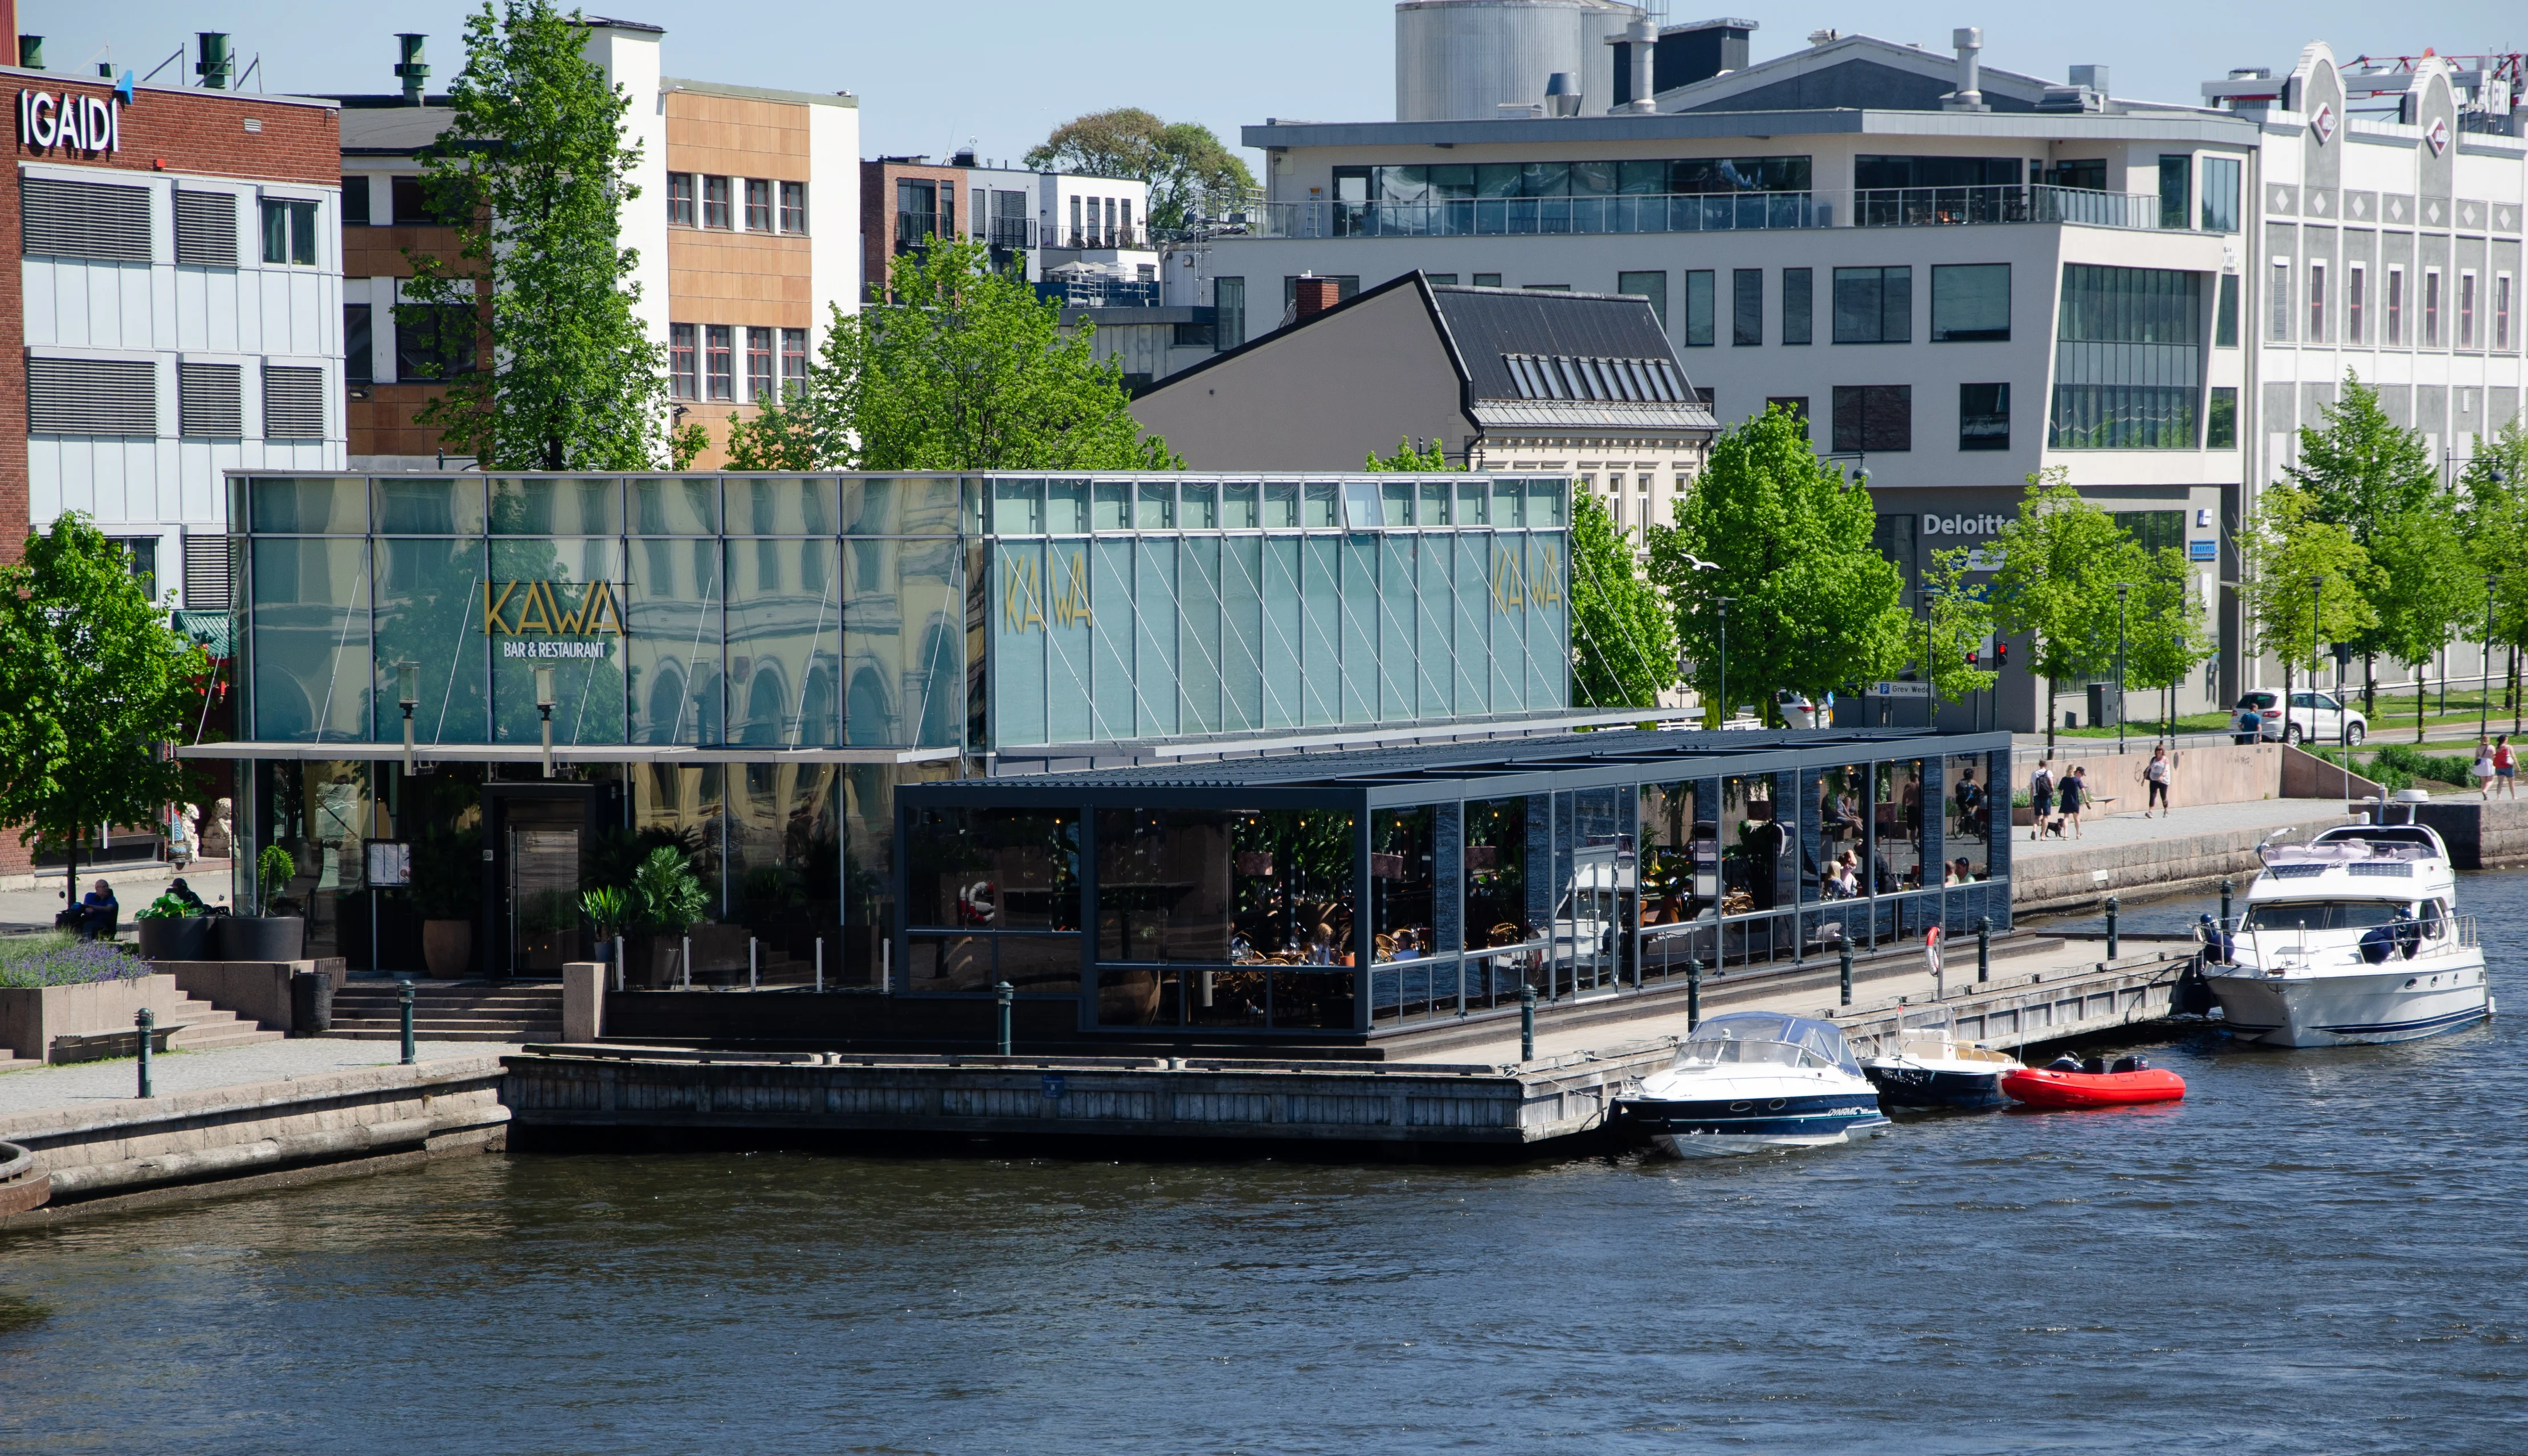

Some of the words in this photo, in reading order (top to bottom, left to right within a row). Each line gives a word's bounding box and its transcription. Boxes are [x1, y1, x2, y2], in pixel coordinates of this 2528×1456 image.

[22, 88, 119, 152] IGAIDI
[484, 578, 624, 636] KAWA
[1006, 550, 1092, 632] KAWA
[1494, 542, 1562, 614] KAWA
[504, 642, 526, 657] BAR
[528, 642, 537, 657] &
[538, 642, 605, 657] RESTAURANT
[1827, 1106, 1860, 1117] DYNAMIC
